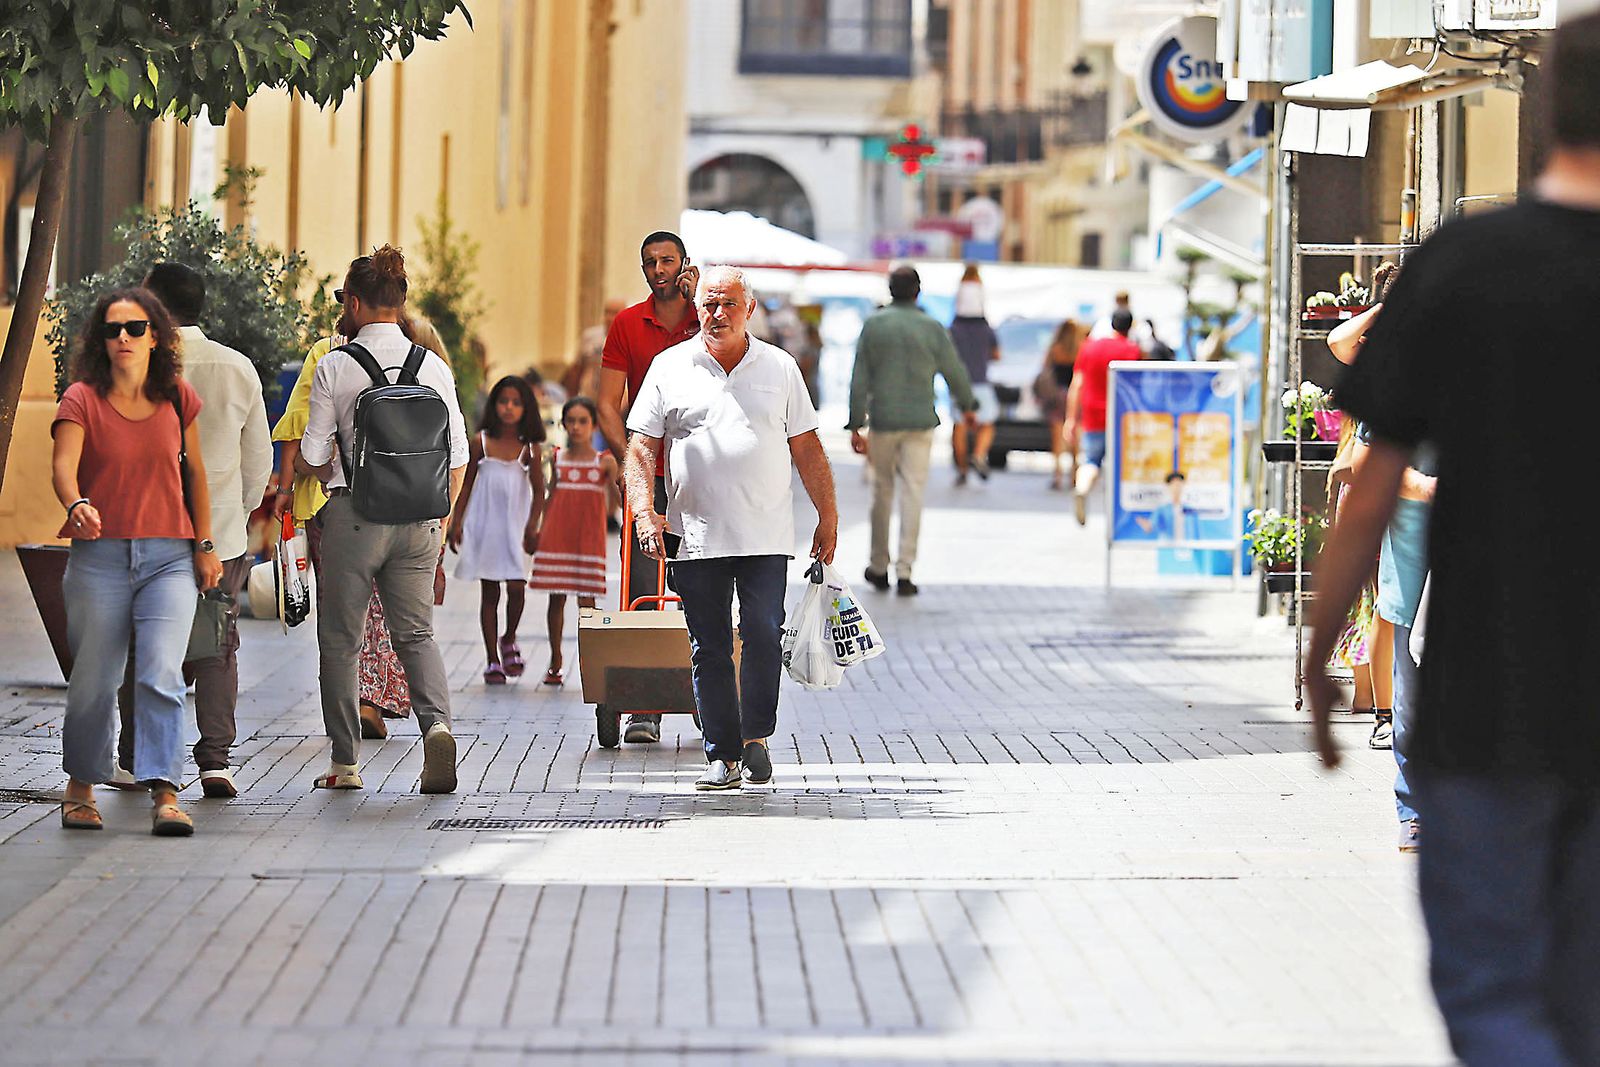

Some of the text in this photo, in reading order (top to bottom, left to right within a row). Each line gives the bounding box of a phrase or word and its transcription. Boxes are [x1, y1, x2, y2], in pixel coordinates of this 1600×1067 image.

[602, 616, 611, 625] B
[834, 634, 874, 658] DE TI
